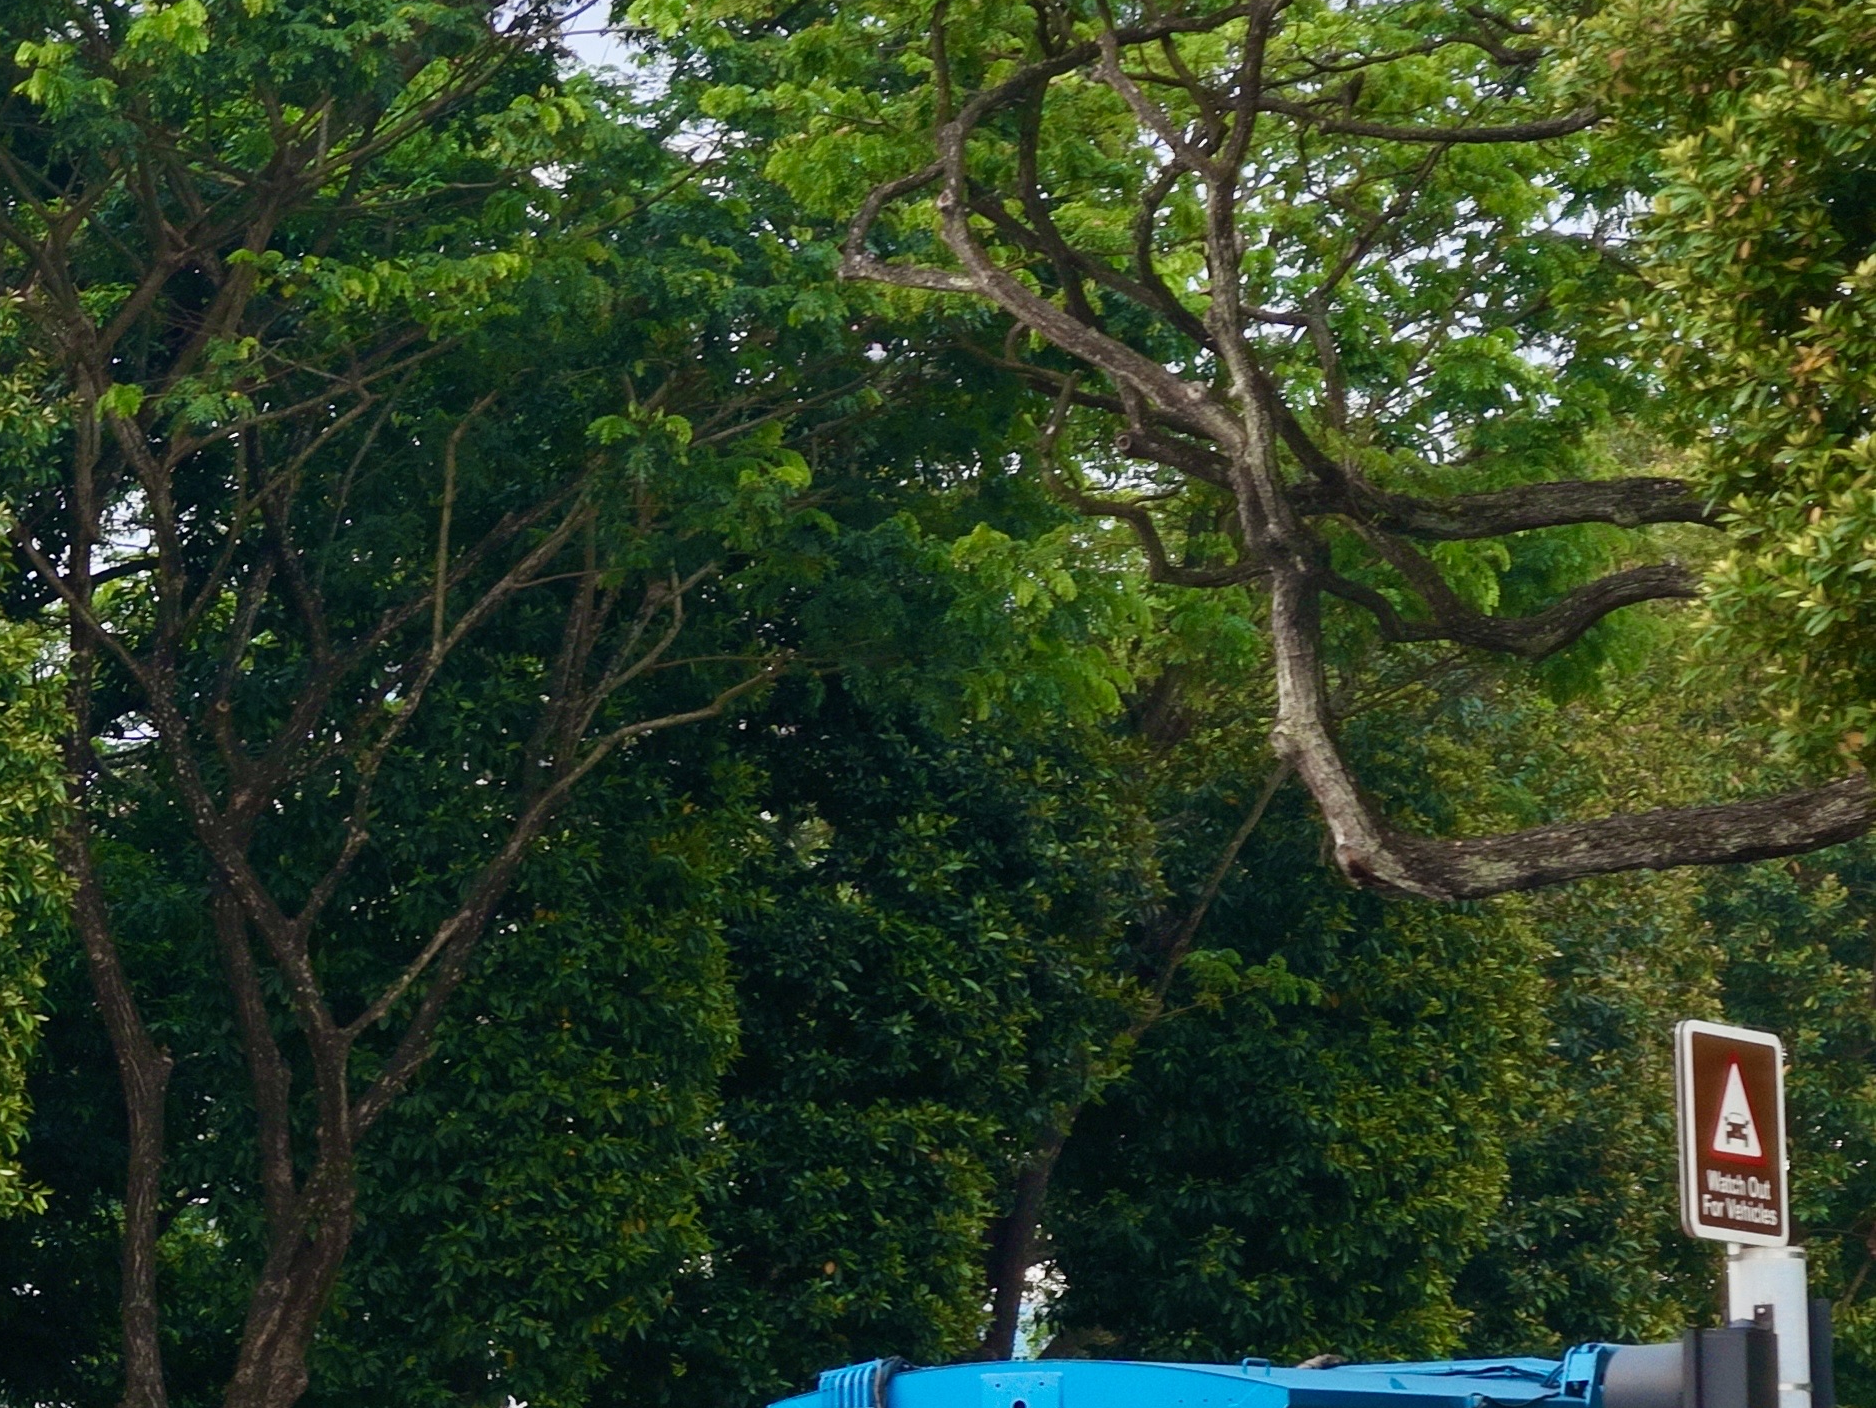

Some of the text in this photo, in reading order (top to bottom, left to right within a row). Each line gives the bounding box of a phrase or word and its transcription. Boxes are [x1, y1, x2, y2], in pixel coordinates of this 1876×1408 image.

[1706, 1169, 1772, 1201] Watch Out
[1702, 1193, 1779, 1226] For Vehicles
